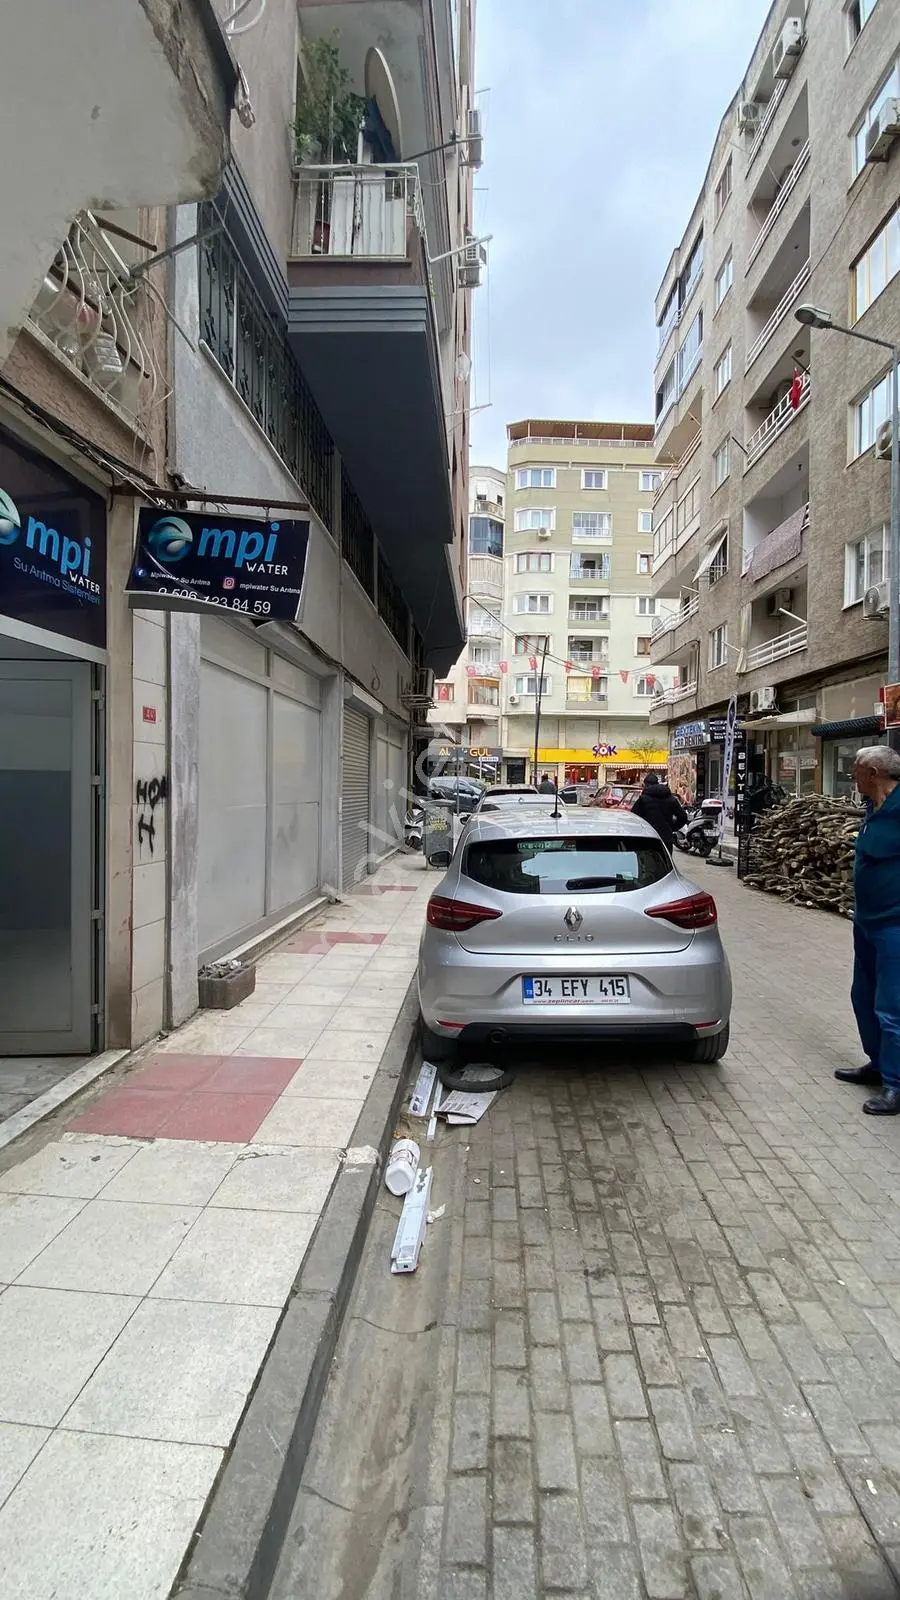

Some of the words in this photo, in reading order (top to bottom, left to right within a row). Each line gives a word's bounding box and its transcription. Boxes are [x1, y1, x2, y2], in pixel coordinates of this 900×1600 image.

[27, 515, 93, 576] mpi
[197, 522, 280, 568] mpi
[13, 556, 28, 572] Su
[246, 562, 289, 576] WATER
[68, 570, 101, 595] WATER
[232, 598, 249, 611] 84
[253, 600, 271, 614] 59
[553, 933, 595, 943] CLIO
[534, 979, 552, 997] 34
[561, 979, 588, 996] EFY
[599, 978, 625, 996] 415
